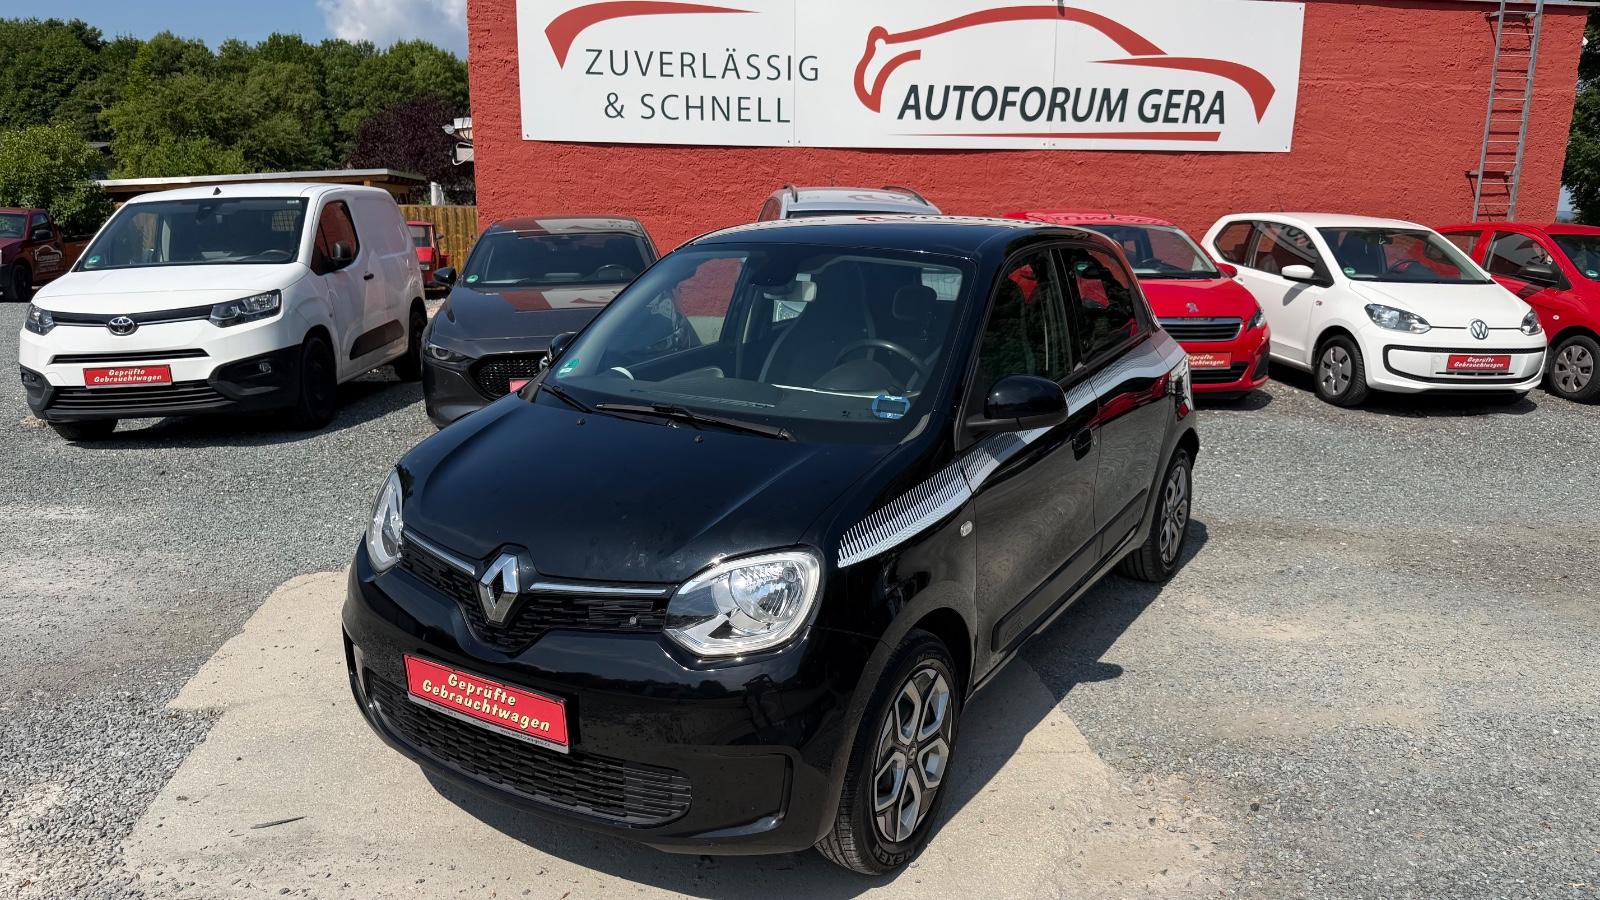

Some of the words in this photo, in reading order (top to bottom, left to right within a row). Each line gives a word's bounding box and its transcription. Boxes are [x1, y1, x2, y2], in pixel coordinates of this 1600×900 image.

[585, 47, 820, 83] ZUVERLÄSSIG
[604, 92, 626, 119] &
[640, 92, 792, 124] SCHNELL
[897, 83, 1129, 123] AUTOFORUM
[1137, 87, 1226, 125] GERA
[94, 374, 162, 383] Gebrauchtwagen
[108, 368, 146, 377] Geprüfte
[422, 679, 551, 733] Gebrauchtwagen
[447, 673, 517, 707] Geprüfte
